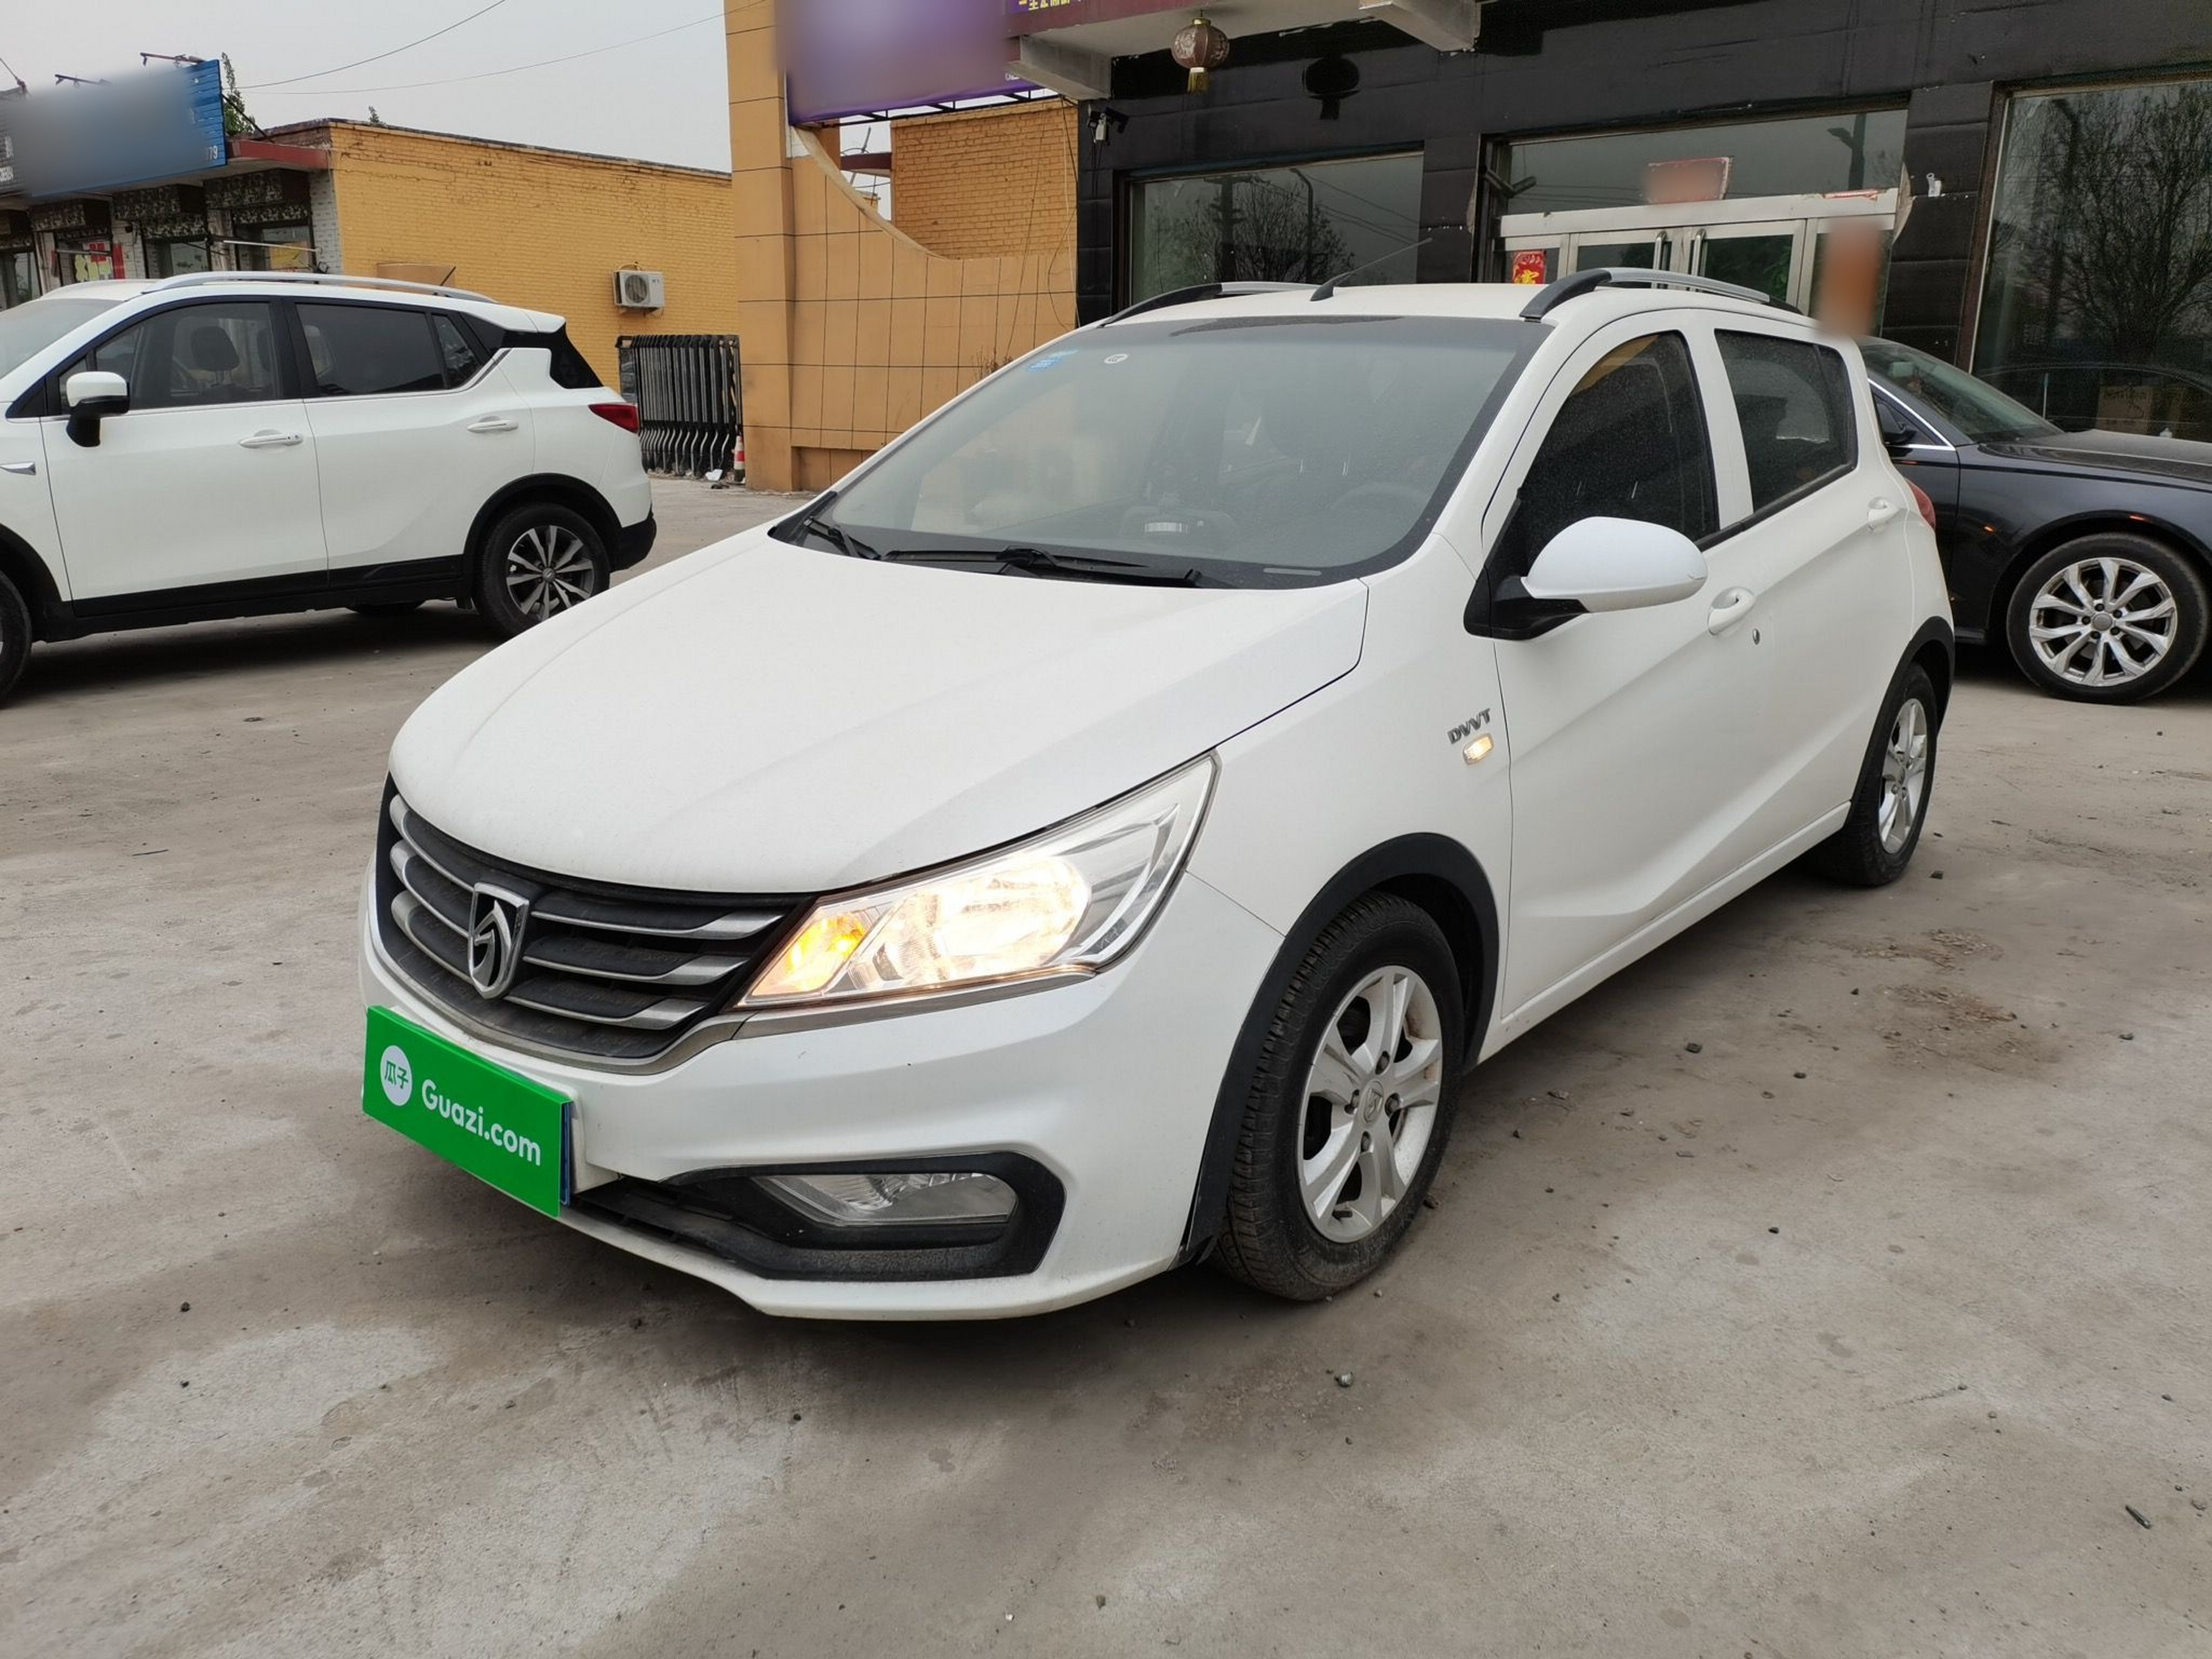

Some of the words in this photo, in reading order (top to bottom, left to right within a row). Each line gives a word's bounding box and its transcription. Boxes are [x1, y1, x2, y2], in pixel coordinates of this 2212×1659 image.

[1447, 708, 1490, 744] DVVT
[384, 1060, 408, 1089] 瓜子
[422, 1079, 540, 1166] Guazi.com
